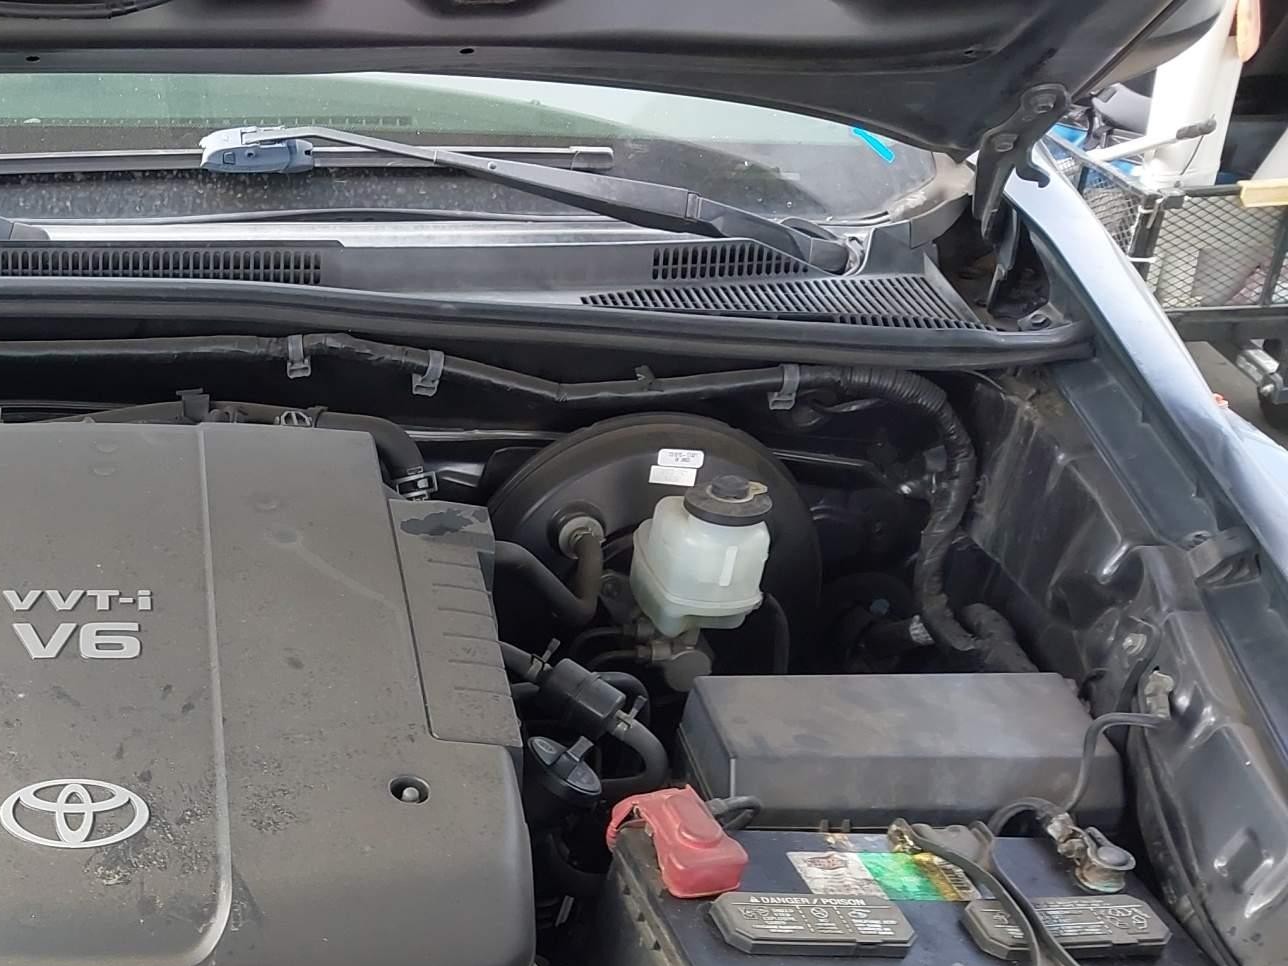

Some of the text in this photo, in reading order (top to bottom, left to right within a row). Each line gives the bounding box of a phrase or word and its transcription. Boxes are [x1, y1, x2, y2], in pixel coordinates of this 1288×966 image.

[3, 589, 153, 612] VVT-i
[12, 622, 142, 660] V6
[760, 896, 811, 905] DANGER
[821, 898, 866, 906] POISON
